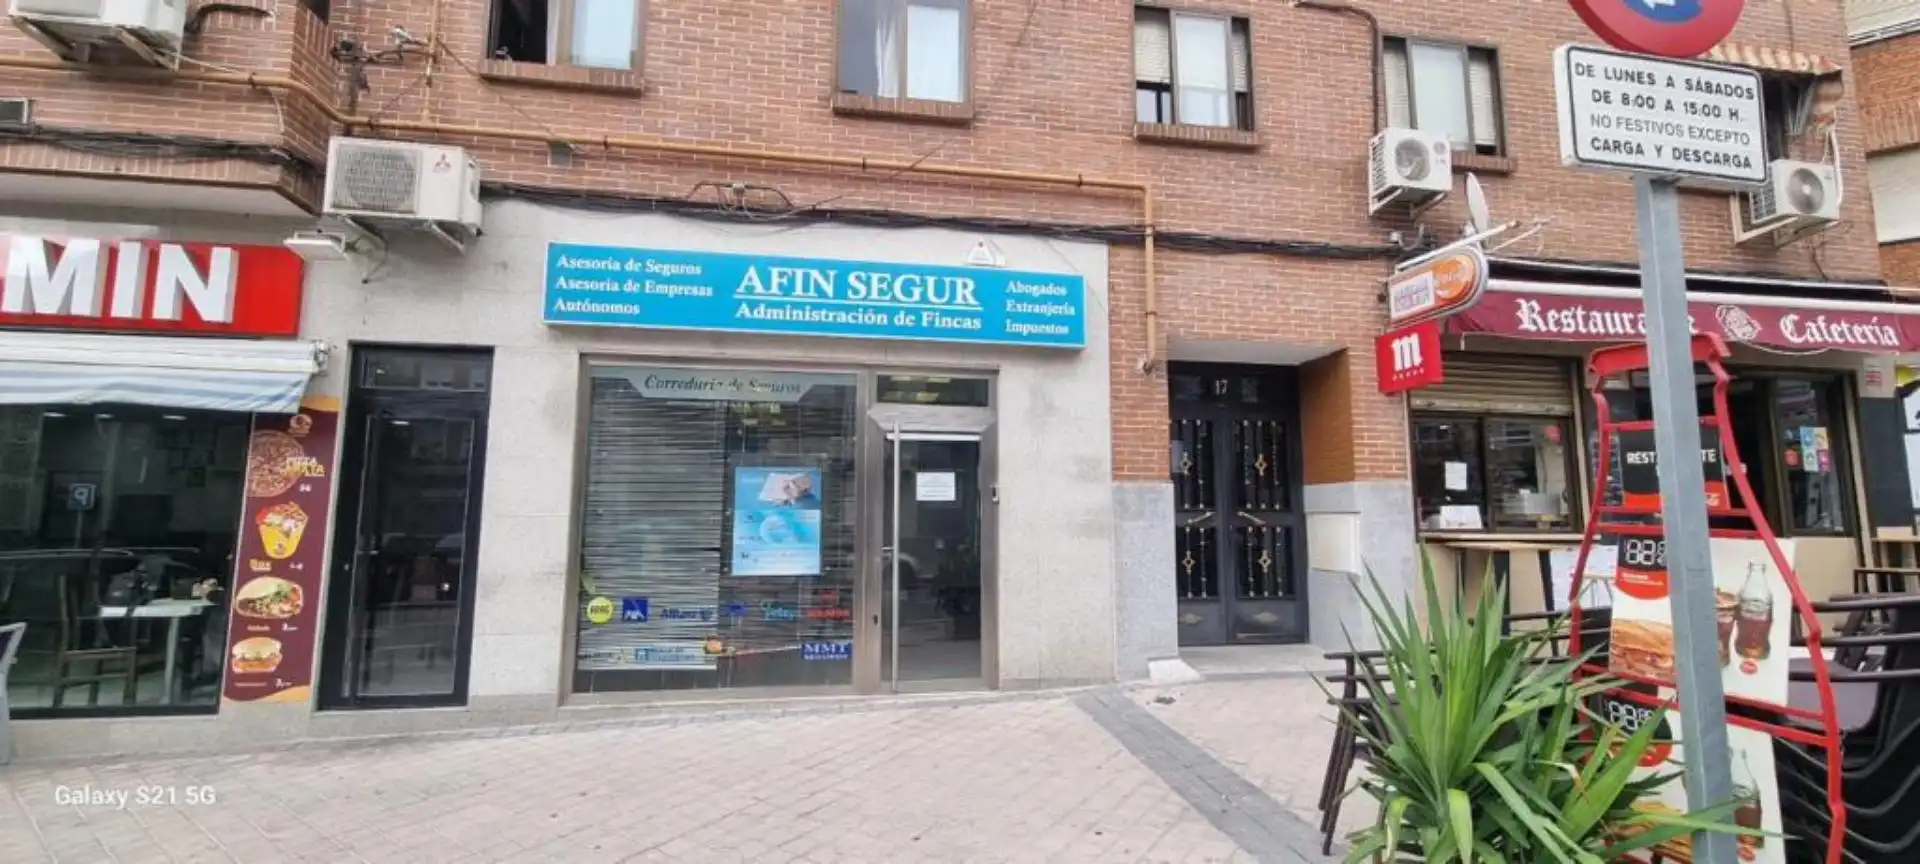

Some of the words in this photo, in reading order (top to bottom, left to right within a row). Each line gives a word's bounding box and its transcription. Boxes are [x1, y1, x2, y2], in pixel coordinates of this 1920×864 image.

[1574, 62, 1596, 78] DE
[1604, 65, 1656, 87] LUNES
[1665, 75, 1676, 89] A
[1684, 75, 1755, 100] SÁBADOS
[1591, 88, 1612, 104] DE
[1621, 92, 1656, 110] 8:00
[1664, 99, 1675, 113] A
[1683, 101, 1722, 118] 15:00
[1590, 113, 1612, 129] NO
[1615, 116, 1685, 137] FESTIVOS
[1688, 125, 1751, 146] EXCEPTO
[1590, 137, 1645, 156] CARGA
[1653, 144, 1664, 160] Y
[1671, 146, 1753, 169] DESCARGA
[1, 236, 237, 323] MIN
[624, 258, 642, 273] de
[644, 258, 702, 277] Seguros
[623, 278, 640, 293] de
[644, 280, 714, 298] Empresas
[736, 265, 836, 298] AFIN
[847, 270, 980, 305] SEGUR
[1005, 280, 1068, 297] Abogados
[554, 297, 640, 315] Autónomos
[735, 302, 888, 328] Administración
[894, 310, 915, 329] de
[921, 312, 982, 331] Fincas
[1005, 318, 1070, 336] Impuestos
[1215, 379, 1228, 396] 17
[804, 642, 847, 654] MMT
